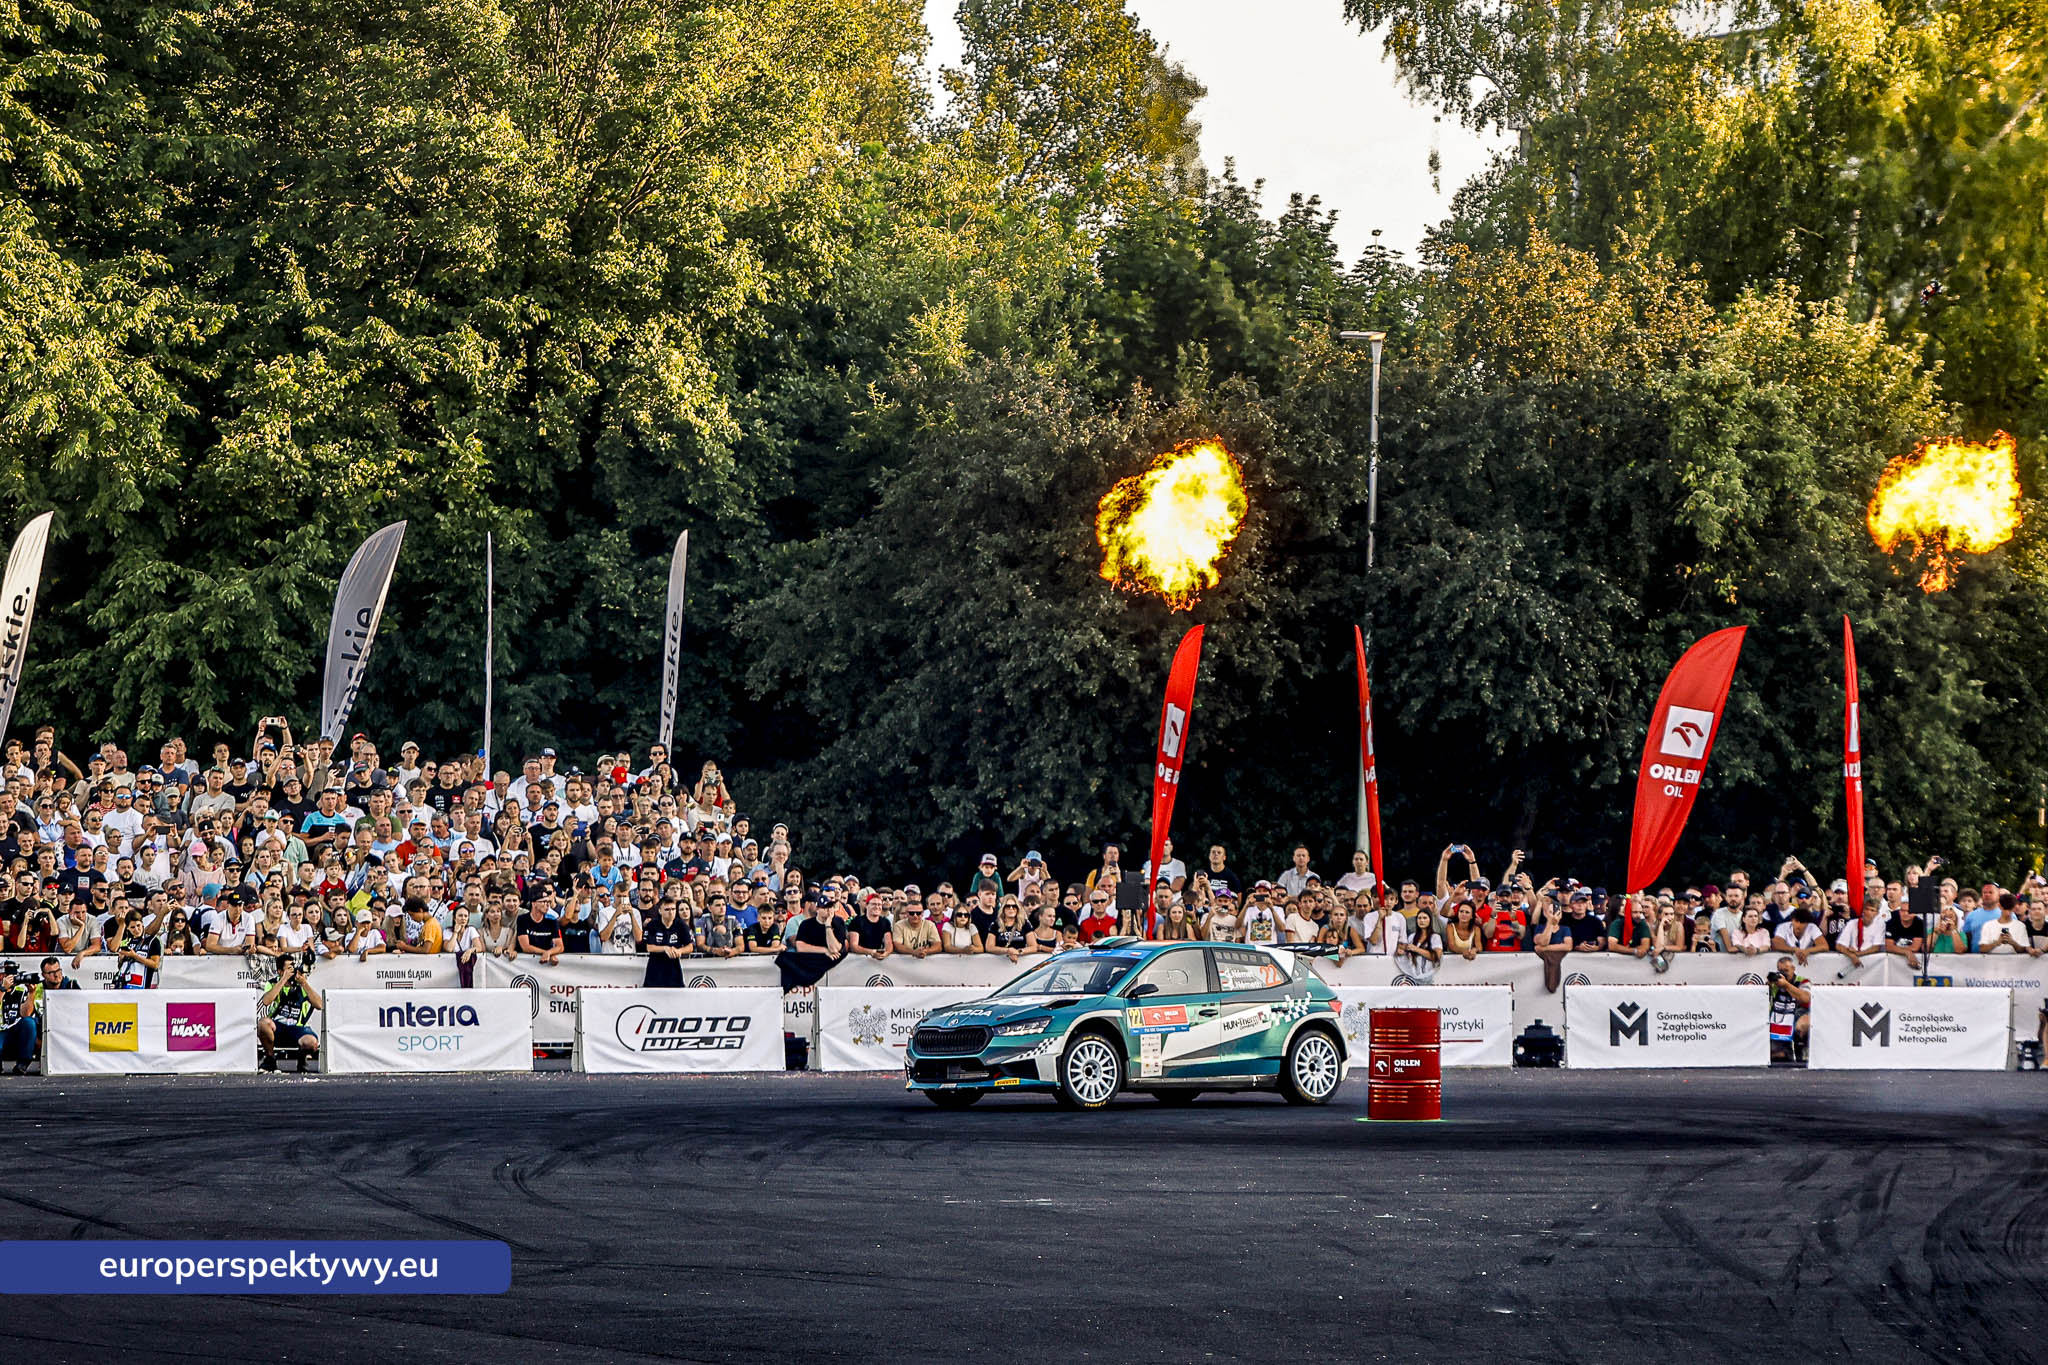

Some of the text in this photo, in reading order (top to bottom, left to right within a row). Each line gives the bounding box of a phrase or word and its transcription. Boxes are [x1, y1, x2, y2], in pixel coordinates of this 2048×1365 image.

[1649, 762, 1701, 784] ORLEN
[1664, 784, 1684, 798] OIL
[376, 968, 432, 981] STADION ŚLĄSKI
[1259, 963, 1283, 987] 22
[378, 1001, 480, 1027] interia
[891, 1007, 925, 1019] Minist
[1128, 1008, 1144, 1027] 22
[171, 1017, 189, 1025] RMF
[647, 1016, 752, 1034] MOTO
[1441, 1018, 1484, 1031] urystyki
[93, 1021, 134, 1036] RMF
[891, 1023, 913, 1036] Spo
[397, 1036, 464, 1052] SPORT
[643, 1036, 744, 1051] WIZJA
[1656, 1033, 1707, 1043] Metropolia
[1898, 1034, 1948, 1045] Metropolia
[1393, 1059, 1421, 1067] ORLEN
